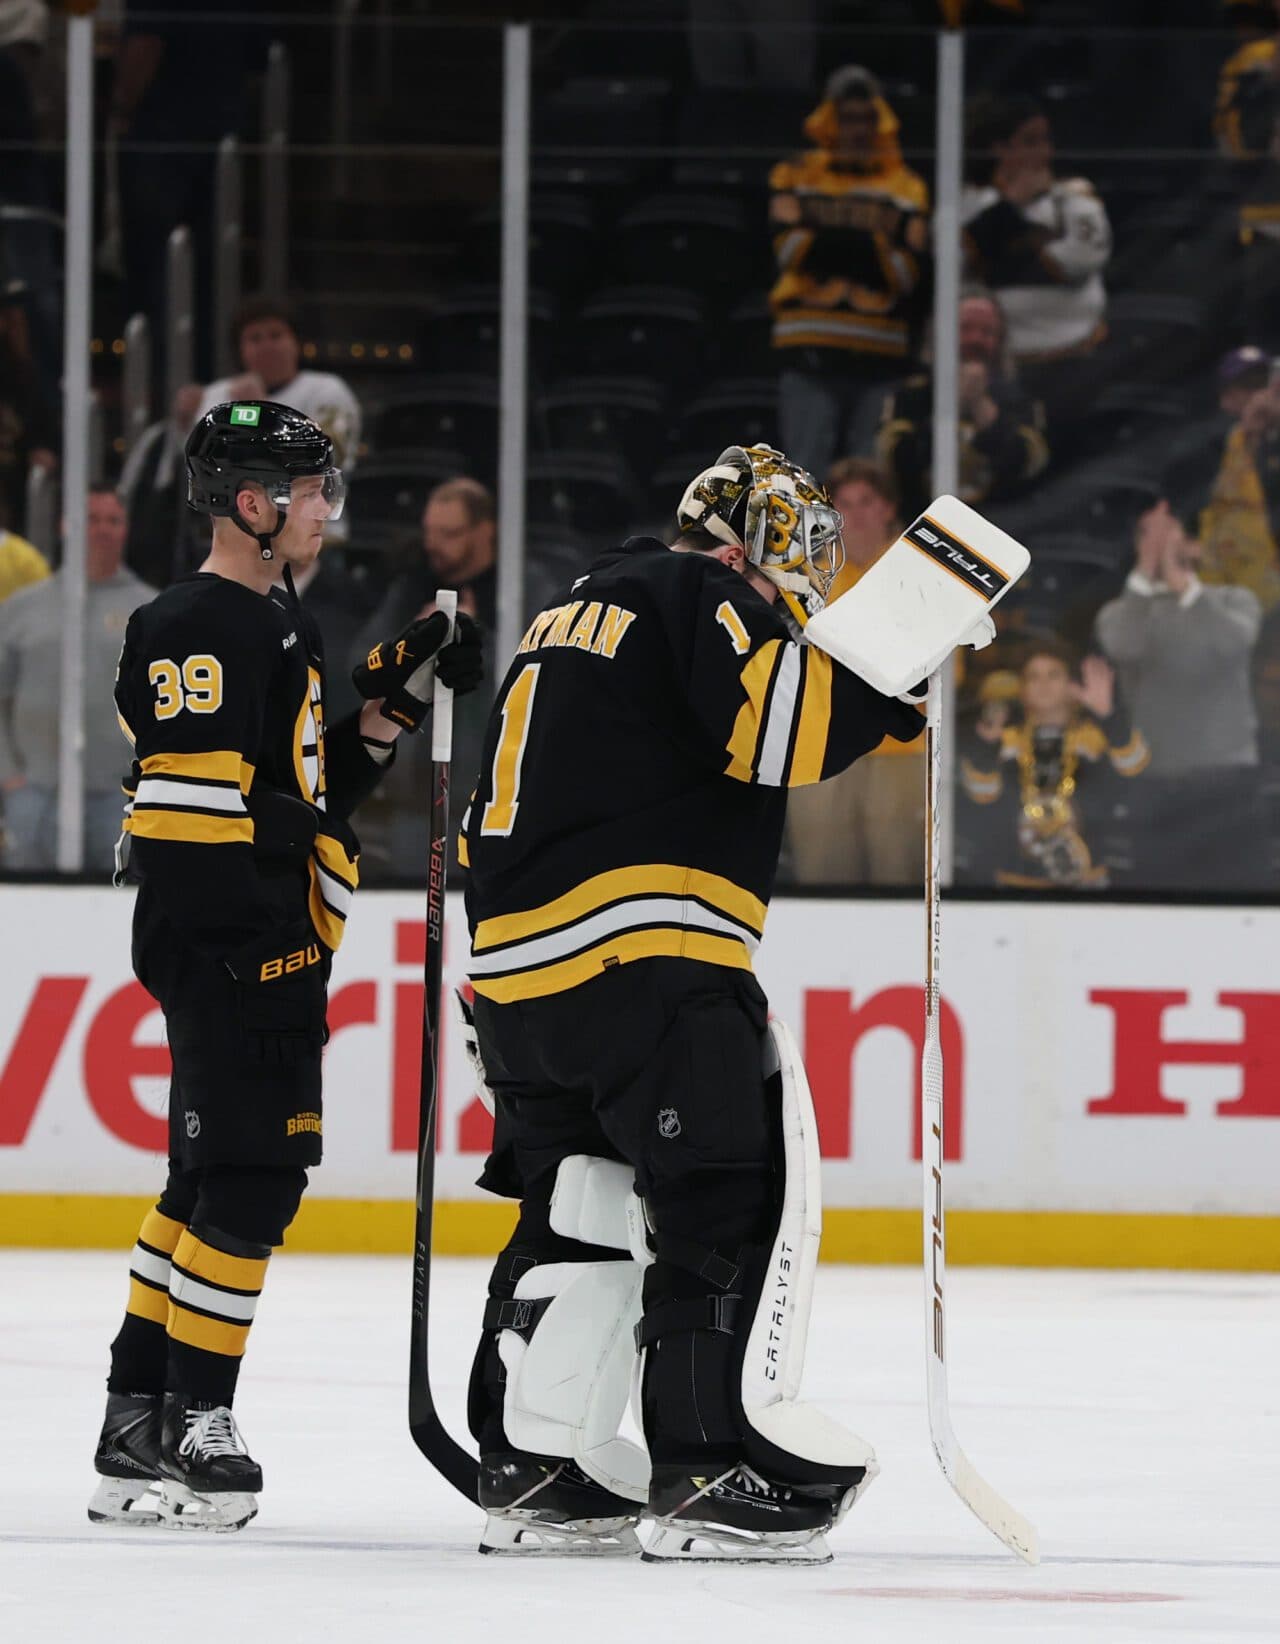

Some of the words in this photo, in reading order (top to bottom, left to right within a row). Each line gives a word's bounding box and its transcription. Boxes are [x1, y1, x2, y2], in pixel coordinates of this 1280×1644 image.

[235, 408, 257, 421] TD
[914, 527, 994, 589] TRUE
[715, 600, 751, 655] 1
[148, 654, 223, 721] 39
[480, 663, 542, 837] 1
[765, 1241, 793, 1381] CATALYST
